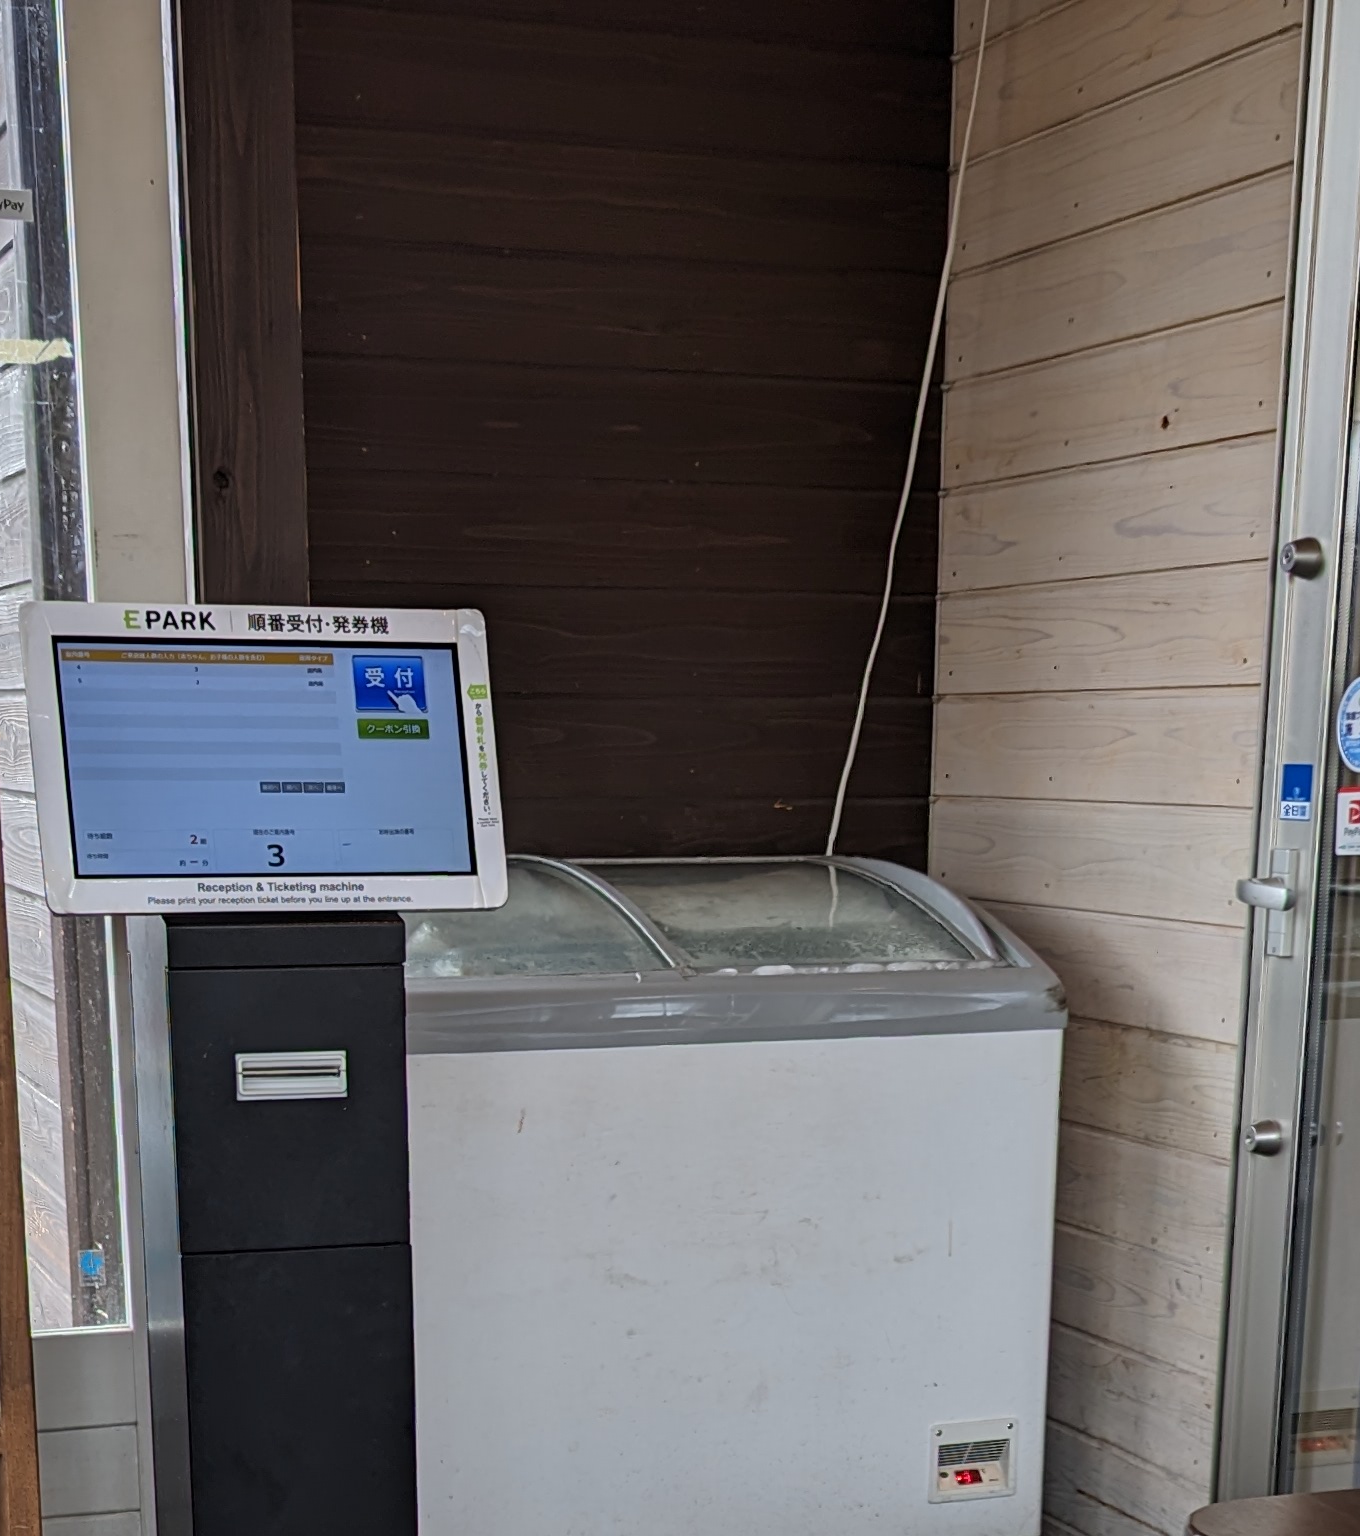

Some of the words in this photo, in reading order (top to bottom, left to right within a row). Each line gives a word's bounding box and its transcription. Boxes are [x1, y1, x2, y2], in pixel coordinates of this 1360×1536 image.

[123, 610, 217, 632] EPARK
[247, 613, 390, 635] 順番受付・発券機
[267, 843, 285, 867] 3
[197, 882, 253, 896] Reception
[268, 881, 316, 894] Ticketing
[319, 881, 365, 893] machine
